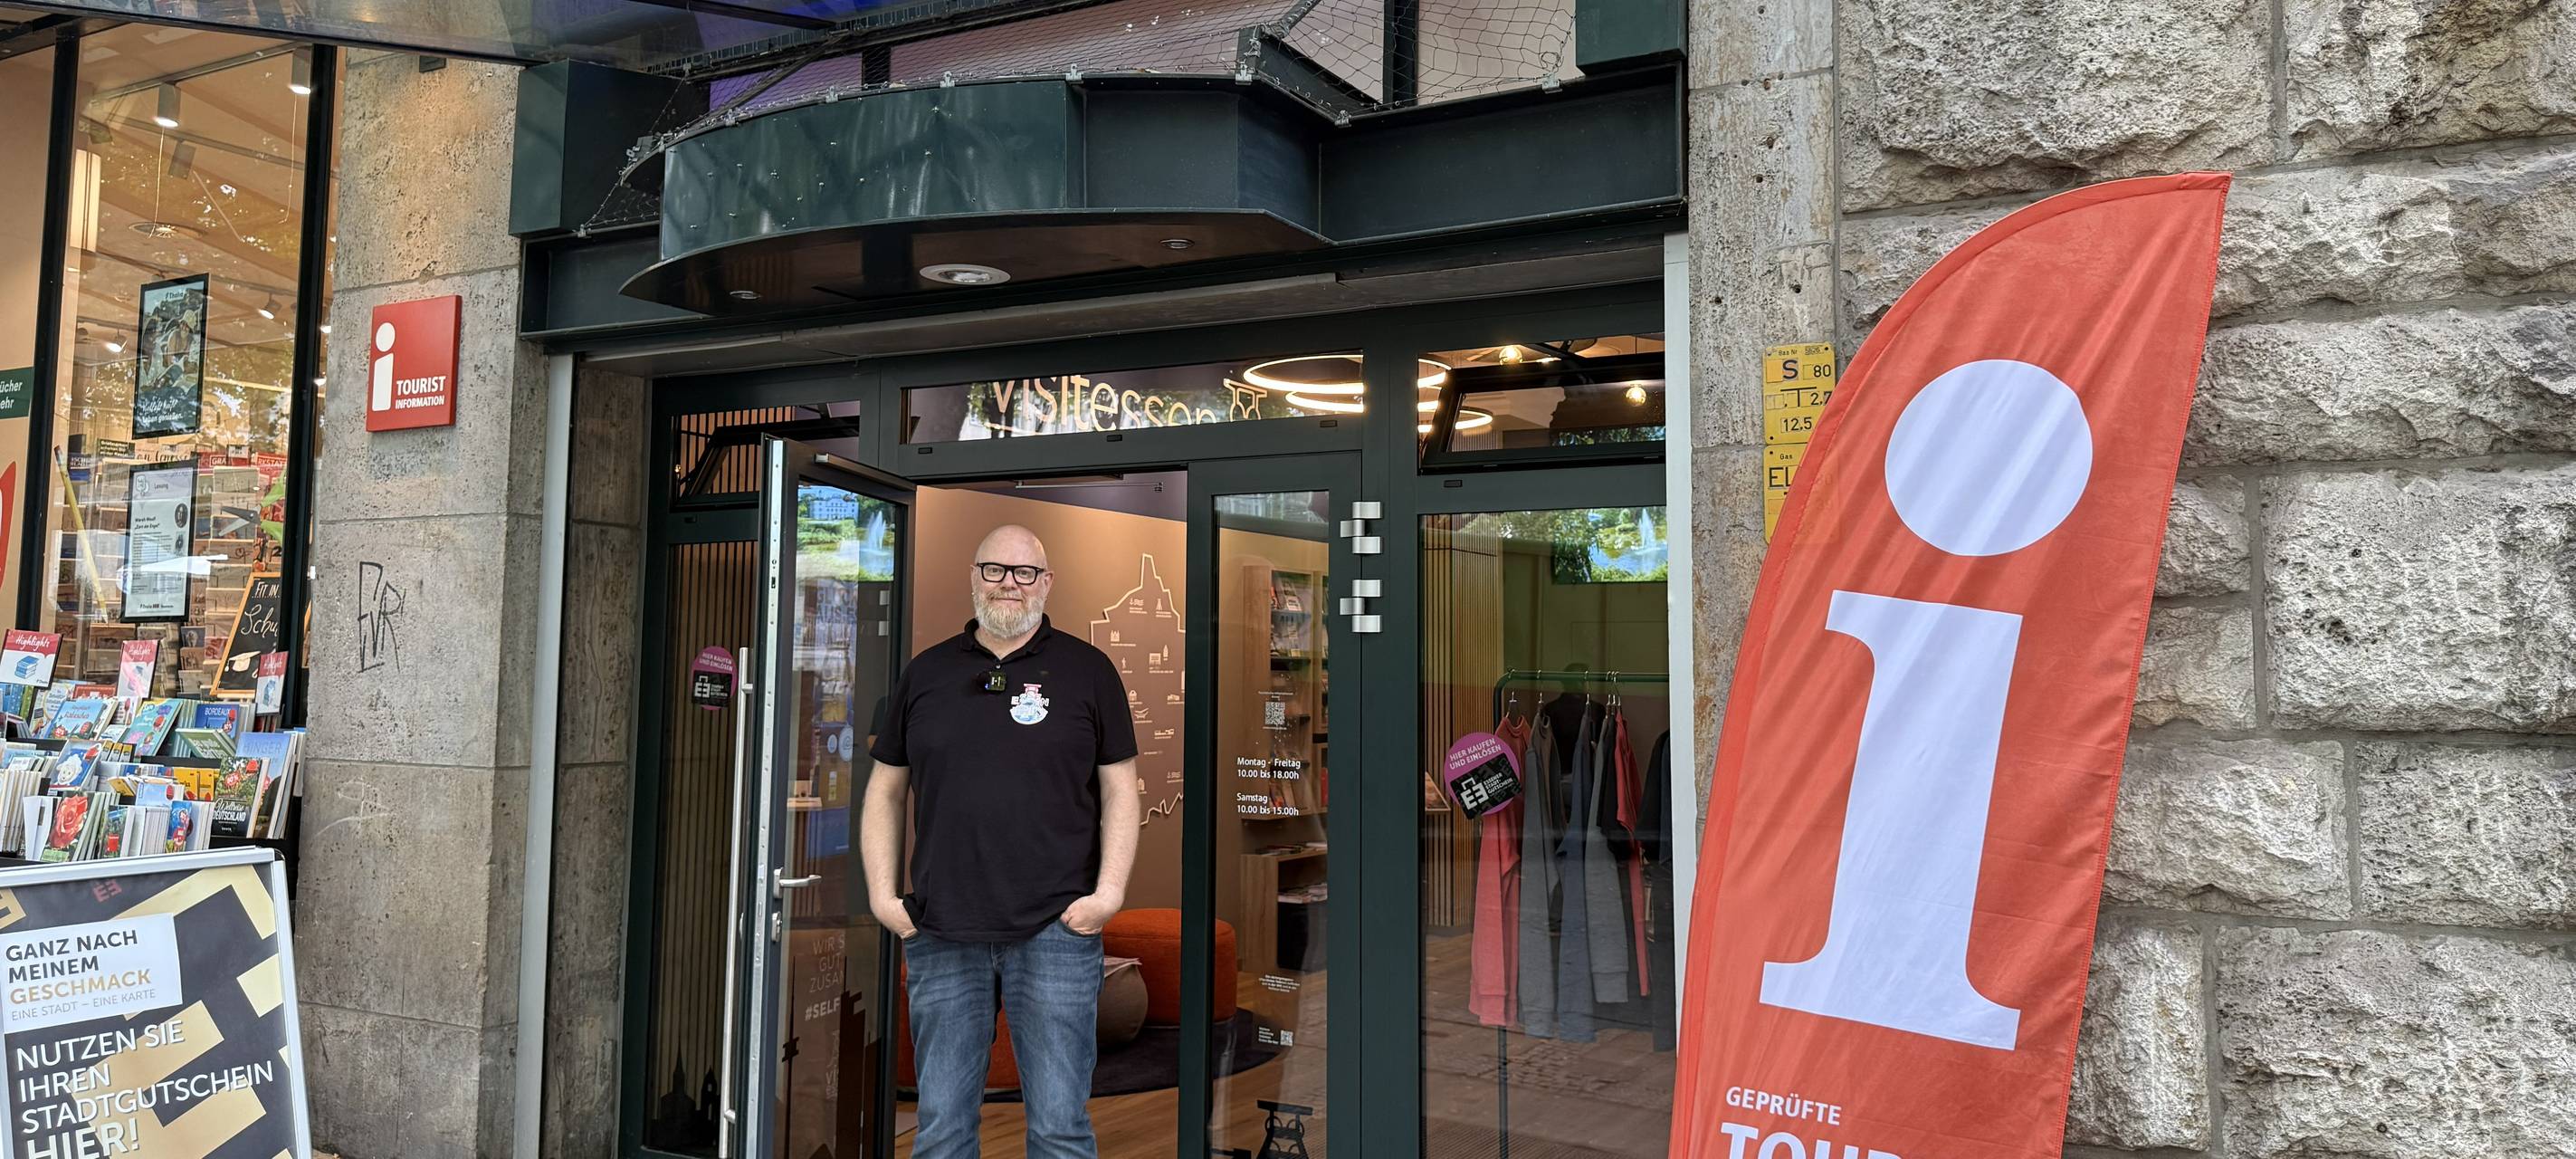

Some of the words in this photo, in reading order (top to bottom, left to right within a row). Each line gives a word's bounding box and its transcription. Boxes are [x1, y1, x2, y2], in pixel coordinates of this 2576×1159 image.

[1782, 359, 1798, 379] S
[1813, 364, 1831, 378] 80
[396, 376, 446, 396] TOURIST
[395, 395, 445, 410] INFORMATION
[1783, 417, 1812, 432] 12,5
[254, 581, 268, 598] FIT
[15, 634, 51, 651] Highlights
[204, 707, 231, 716] BORDEAUX
[1449, 752, 1466, 761] HIER
[1467, 738, 1496, 754] KAUFEN
[1449, 759, 1466, 770] UND
[1466, 744, 1503, 764] EINLÖSEN
[1236, 757, 1266, 768] Montag
[1274, 758, 1301, 770] Freitag
[1237, 769, 1258, 778] 10.00
[1260, 770, 1271, 779] bis
[1273, 770, 1300, 780] 18.00h
[1236, 792, 1268, 804] Samstag
[1237, 804, 1258, 813] 10.00
[1259, 805, 1271, 814] bis
[1273, 807, 1300, 816] 15.00h
[5, 938, 71, 962] GANZ
[76, 929, 138, 952] NACH
[8, 955, 100, 983] MEINEM
[9, 968, 152, 1005] GESCHMACK
[12, 1007, 38, 1021] EINE
[42, 1001, 78, 1016] STADT
[93, 993, 119, 1008] EINE
[121, 989, 157, 1003] KARTE
[16, 1028, 138, 1072] NUTZEN
[144, 1020, 186, 1049] SIE
[20, 1062, 111, 1103] IHREN
[22, 1060, 274, 1134] STADTGUTSCHEIN
[1725, 1086, 1843, 1126] GEPRÜFTE
[26, 1117, 139, 1159] HIER!
